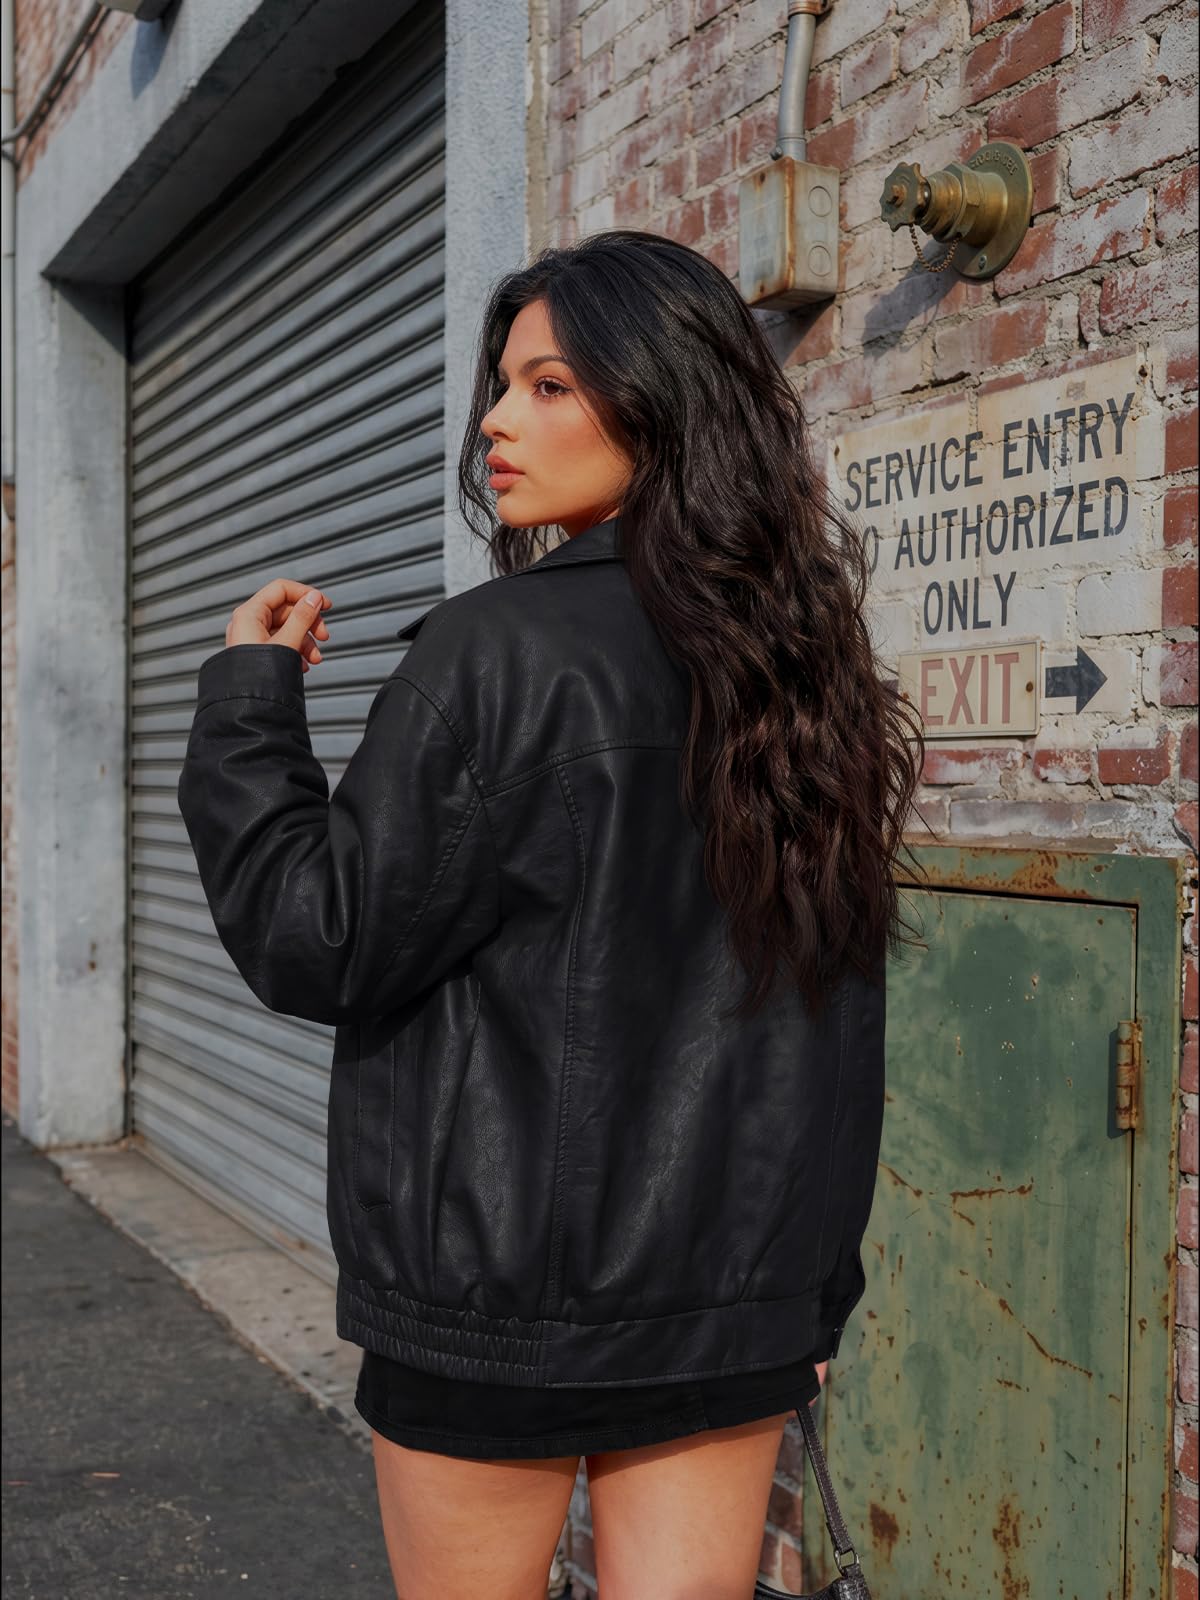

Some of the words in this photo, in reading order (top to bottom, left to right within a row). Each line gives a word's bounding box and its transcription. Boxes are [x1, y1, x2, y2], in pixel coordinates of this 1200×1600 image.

[844, 431, 984, 512] SERVICE
[1002, 392, 1136, 480] ENTRY
[894, 476, 1129, 571] AUTHORIZED
[923, 571, 1017, 636] ONLY
[920, 652, 1020, 727] EXIT
